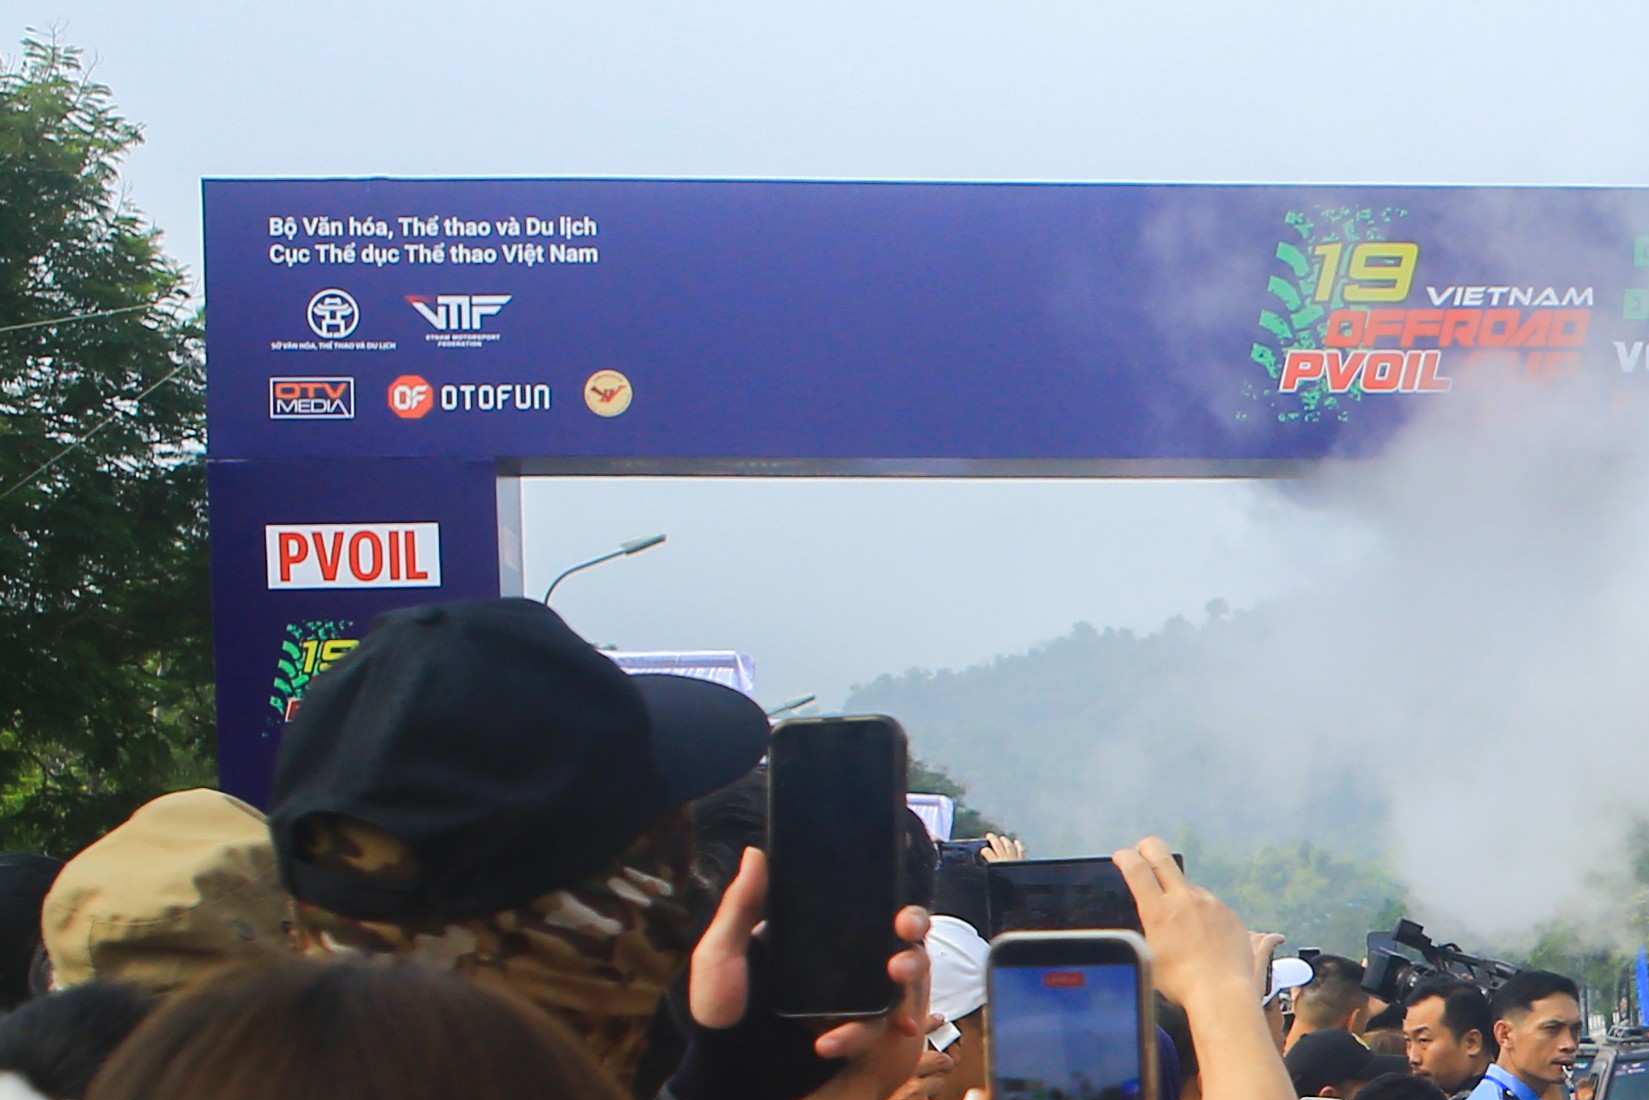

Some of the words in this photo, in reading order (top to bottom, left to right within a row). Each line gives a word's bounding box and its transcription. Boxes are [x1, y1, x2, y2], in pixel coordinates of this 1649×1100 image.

[269, 216, 297, 240] Bộ
[304, 216, 343, 237] Văn
[349, 216, 394, 240] hóa,
[398, 215, 439, 237] Thể
[444, 217, 491, 237] thao
[496, 216, 520, 237] và
[526, 217, 554, 237] Du
[559, 216, 597, 240] lịch
[269, 245, 311, 267] Cục
[315, 242, 356, 263] Thể
[361, 243, 400, 267] dục
[404, 242, 445, 263] Thể
[450, 244, 497, 263] thao
[502, 242, 544, 267] Việt
[550, 245, 599, 263] Nam
[1312, 242, 1420, 302] 19
[1426, 286, 1595, 307] VIETNAM
[1324, 308, 1593, 347] OFFROAD
[1278, 349, 1452, 393] PVOIL
[275, 382, 347, 399] OTV
[393, 384, 428, 410] OF
[441, 384, 550, 411] OTOFUN
[276, 398, 349, 417] MEDIA
[278, 530, 429, 583] PVOIL
